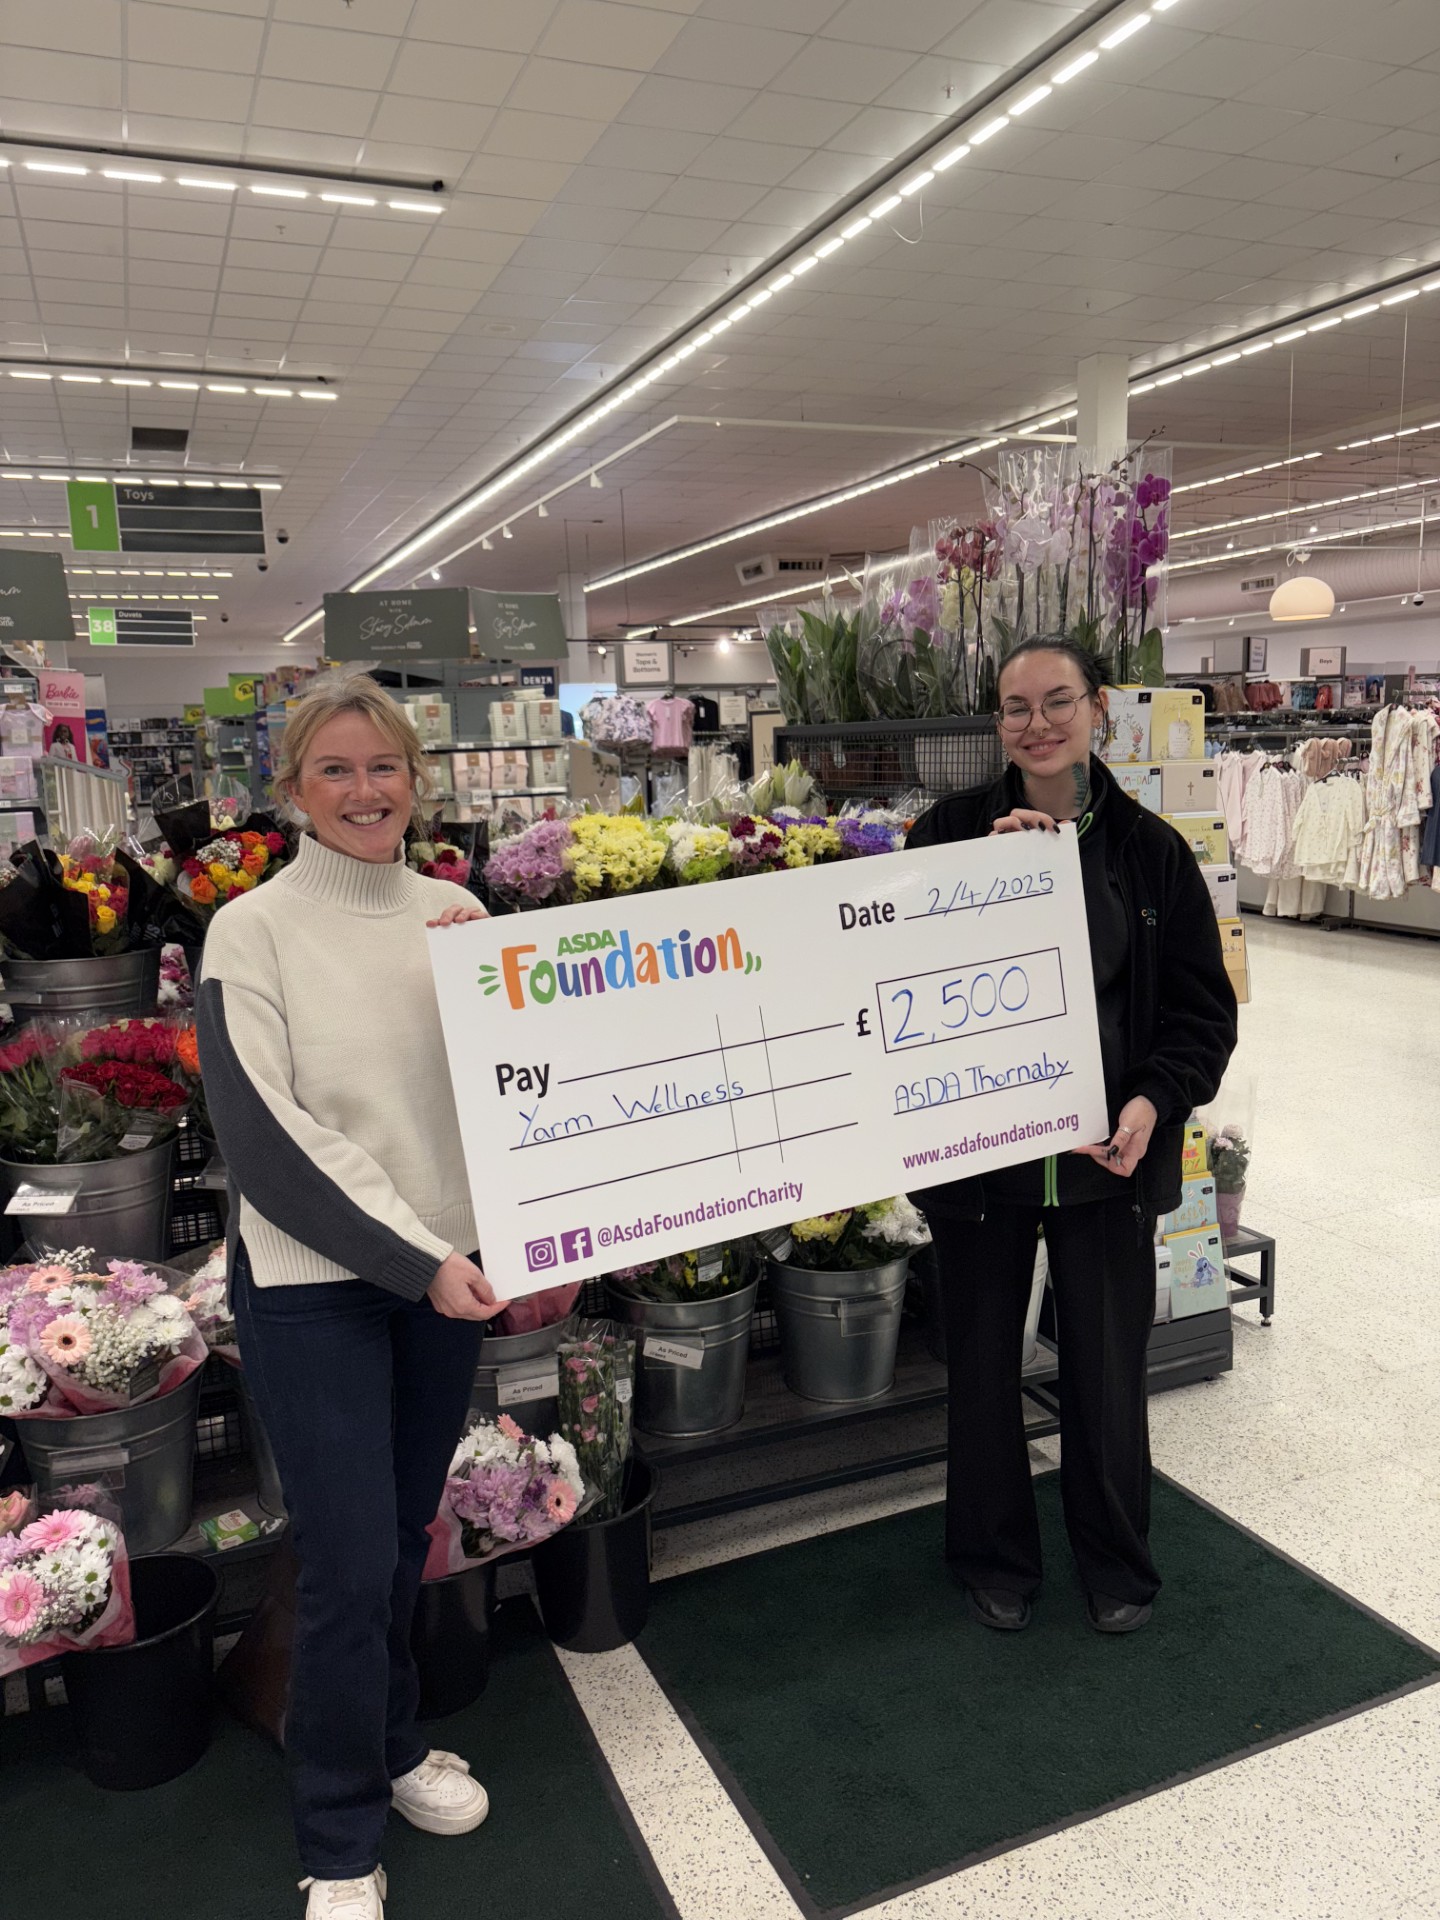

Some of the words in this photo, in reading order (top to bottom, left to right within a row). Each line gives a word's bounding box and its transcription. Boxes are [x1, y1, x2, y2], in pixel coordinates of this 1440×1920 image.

[123, 488, 155, 502] Toys
[85, 504, 99, 529] 1
[118, 610, 143, 619] Duvets
[391, 599, 412, 607] HOME
[92, 619, 114, 633] 38
[45, 683, 80, 700] Barbie
[523, 676, 553, 685] DENIM
[928, 870, 1054, 917] 2/4/2025
[838, 900, 896, 931] Date
[557, 929, 617, 957] ASDA
[501, 927, 744, 1011] Foundation
[891, 966, 1030, 1044] 2,500
[856, 1008, 872, 1037] £
[495, 1063, 551, 1098] Pay
[894, 1071, 961, 1113] ASDA
[965, 1051, 1070, 1090] Thornaby
[518, 1104, 594, 1147] Yarm
[612, 1080, 744, 1119] Wellness
[903, 1113, 1080, 1169] www.asdafoundation.org
[597, 1181, 804, 1247] @AsdaFoundationCharity
[667, 1348, 689, 1359] Priced
[512, 1387, 521, 1395] As
[522, 1384, 543, 1393] Priced
